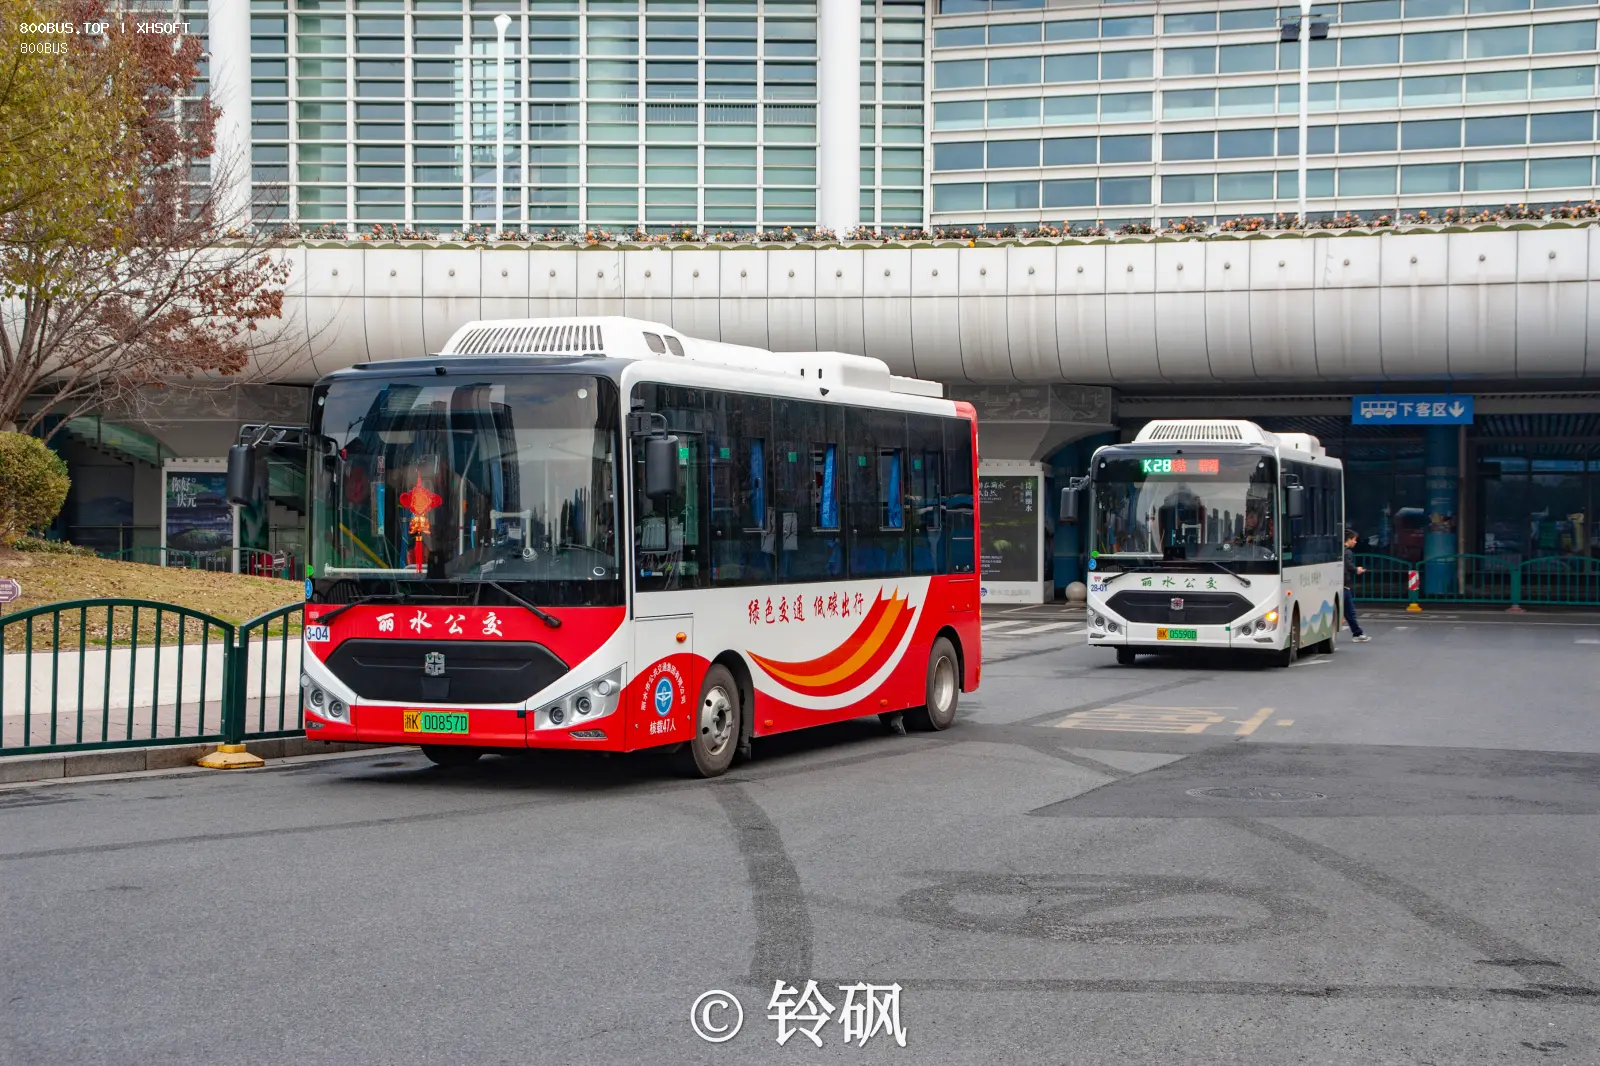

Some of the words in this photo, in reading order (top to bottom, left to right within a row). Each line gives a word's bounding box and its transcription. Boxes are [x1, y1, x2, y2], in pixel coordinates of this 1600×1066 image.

[1399, 401, 1448, 417] 下客区
[1143, 459, 1171, 472] K28
[1090, 583, 1108, 592] 28-01
[1140, 576, 1218, 590] 丽水公交
[748, 594, 805, 625] 绿色交通
[813, 591, 864, 619] 低碳出行
[375, 609, 503, 637] 丽水公交
[307, 625, 329, 641] 3-04
[649, 718, 677, 735] 核载47人
